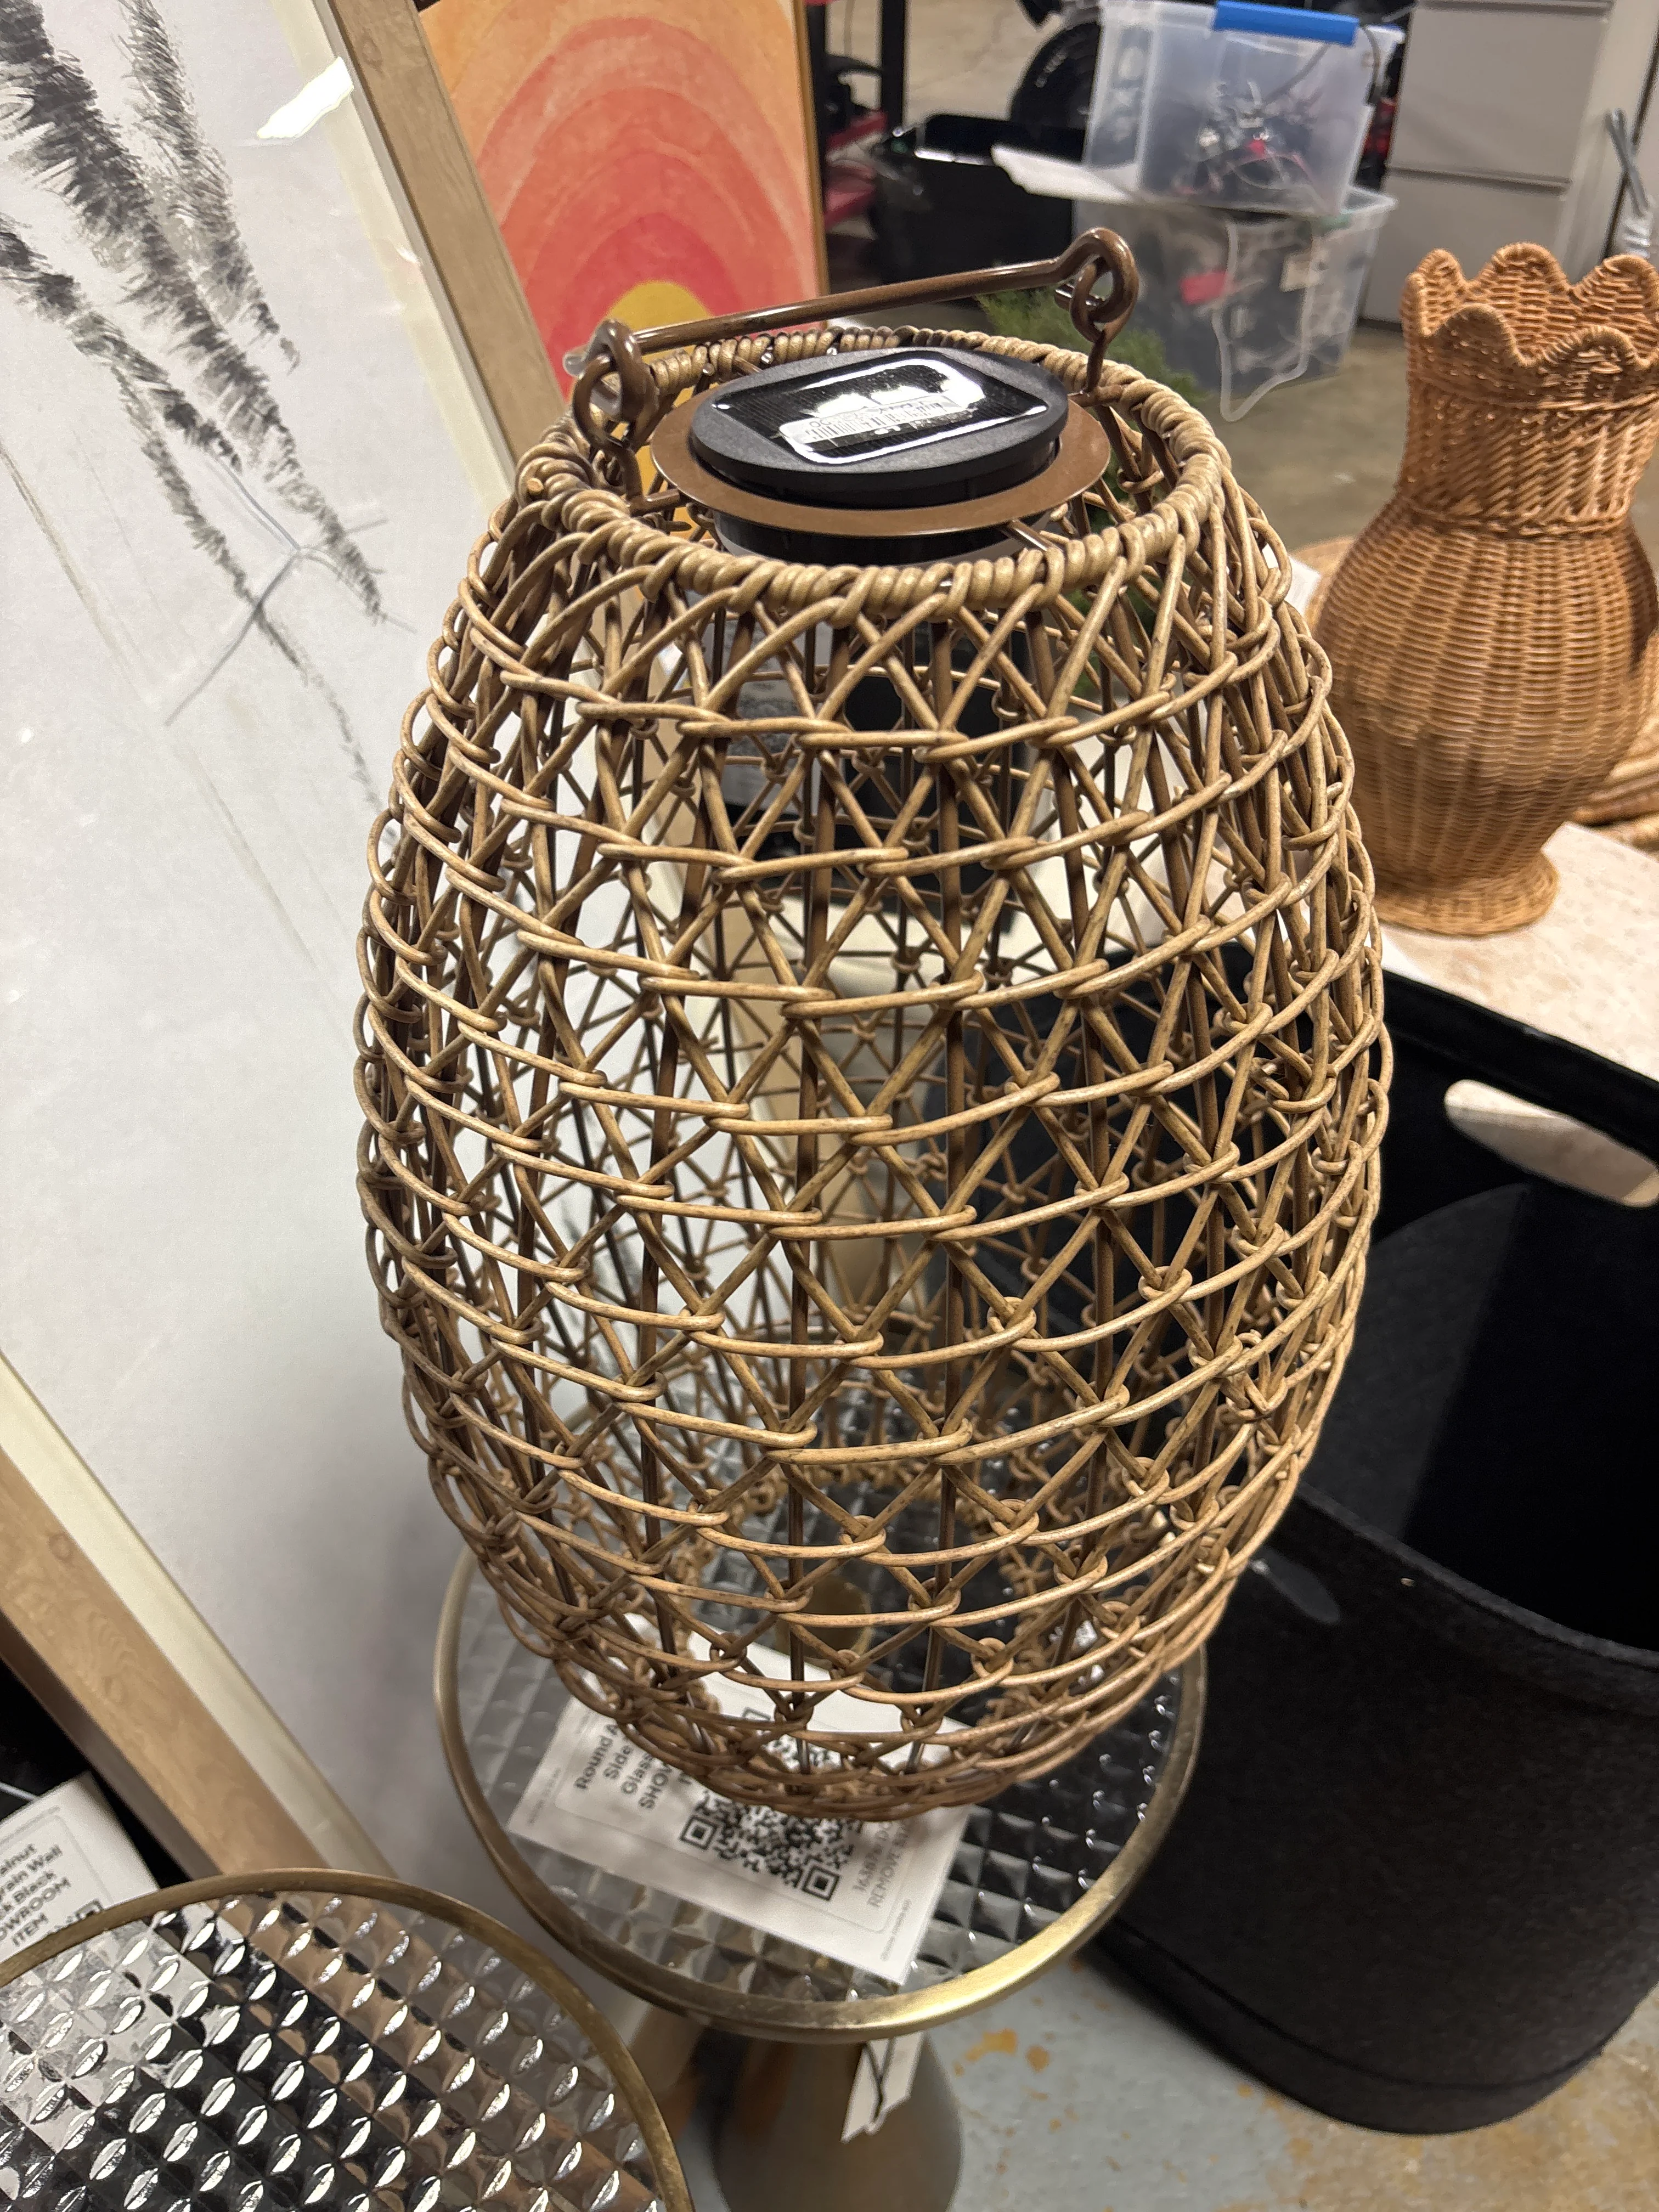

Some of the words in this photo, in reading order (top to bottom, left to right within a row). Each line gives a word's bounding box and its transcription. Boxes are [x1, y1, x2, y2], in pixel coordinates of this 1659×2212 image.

[574, 1735, 613, 1791] Round
[603, 1745, 633, 1779] Side
[0, 1844, 36, 1877] alnut
[12, 1912, 48, 1947] ITEM
